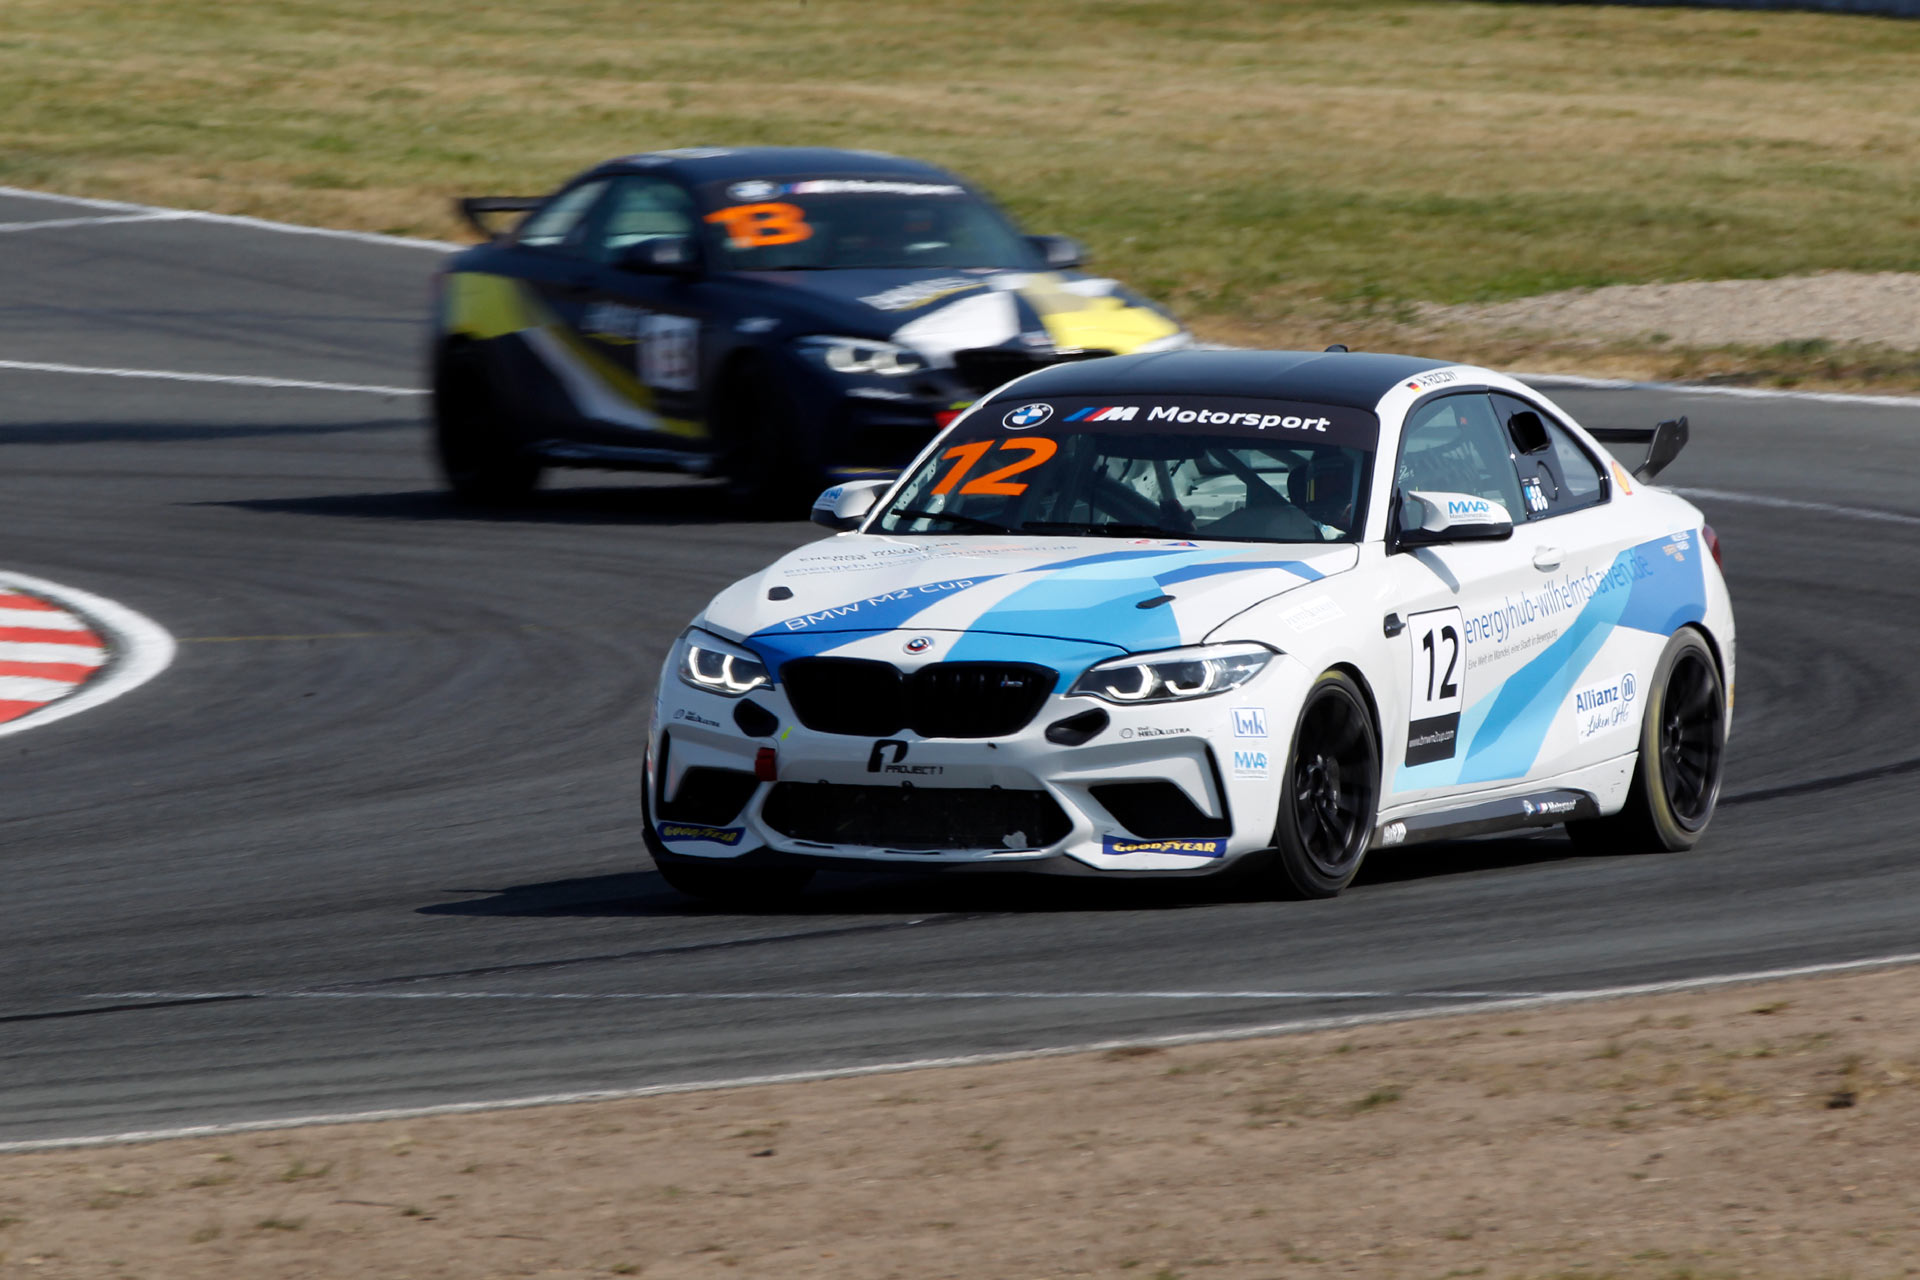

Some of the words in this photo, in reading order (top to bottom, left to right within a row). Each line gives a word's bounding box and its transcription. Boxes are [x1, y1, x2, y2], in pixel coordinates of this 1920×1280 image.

[1147, 406, 1331, 432] Motorsport
[930, 437, 1058, 496] 12
[784, 602, 860, 631] BMW
[867, 587, 913, 607] M2
[916, 578, 976, 595] Cup
[1465, 555, 1654, 643] energyhub-wilhelmshaven.de
[1423, 625, 1459, 701] 12
[1576, 686, 1619, 714] Allianz
[885, 764, 937, 775] PROJECT
[663, 826, 737, 842] GOODYEAR
[1113, 841, 1216, 853] GOODYEAR
